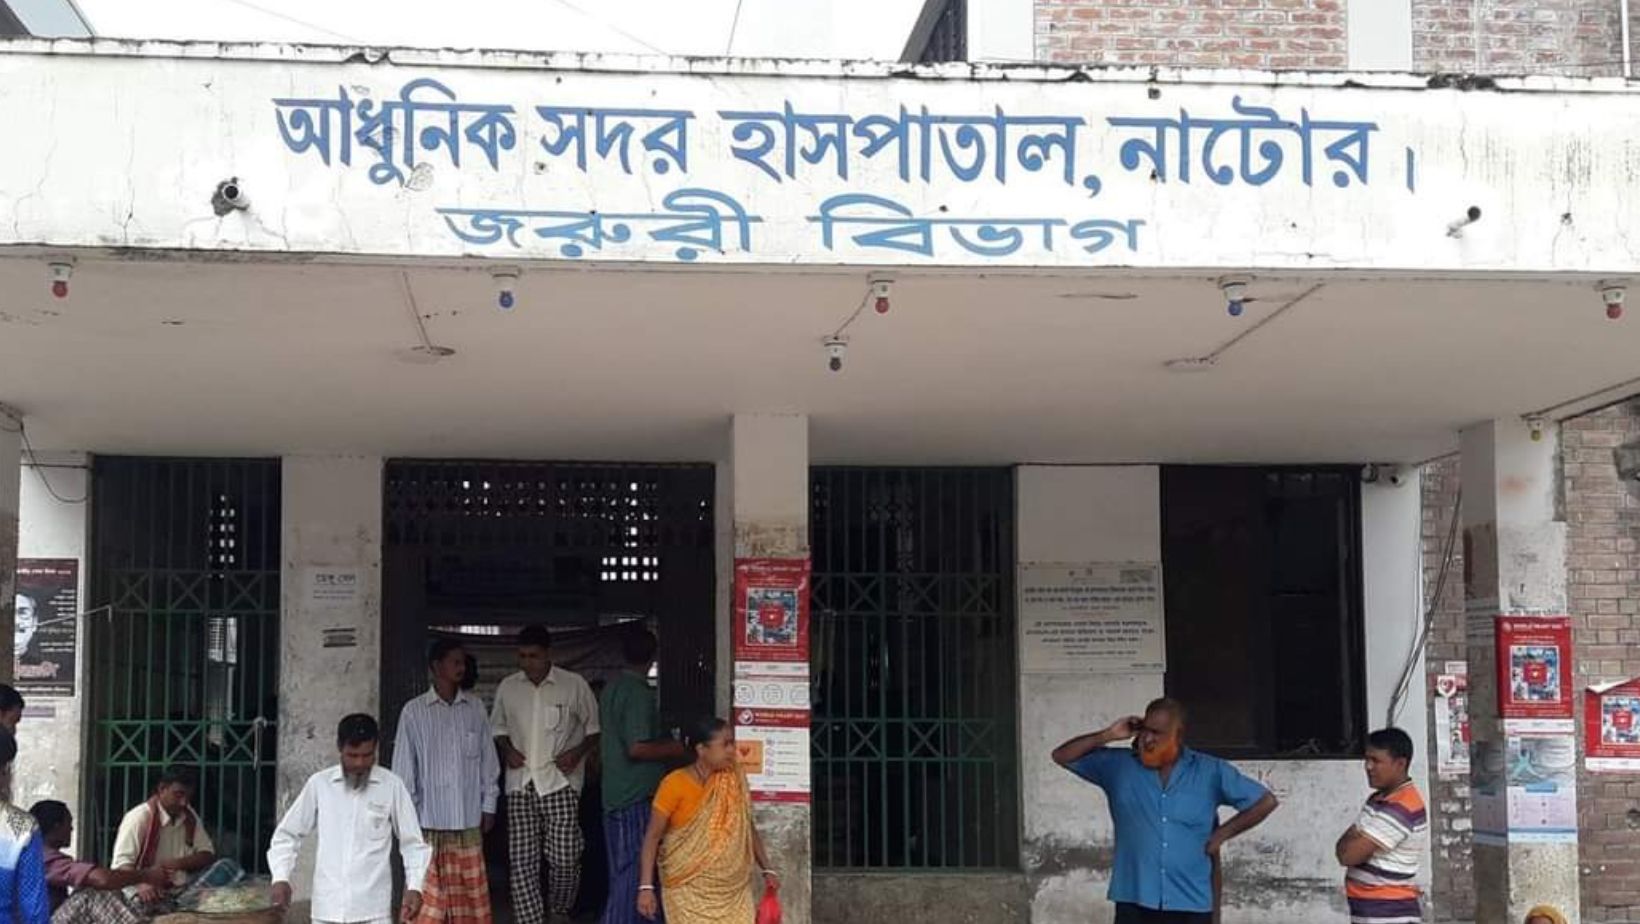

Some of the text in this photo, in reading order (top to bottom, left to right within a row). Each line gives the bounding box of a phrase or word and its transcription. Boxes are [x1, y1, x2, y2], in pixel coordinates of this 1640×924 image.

[272, 77, 517, 187] আধুনিক
[535, 105, 696, 176] সদর
[716, 99, 1101, 198] হাসপাতাল,
[434, 187, 1147, 261] জরুরী বিভাগ
